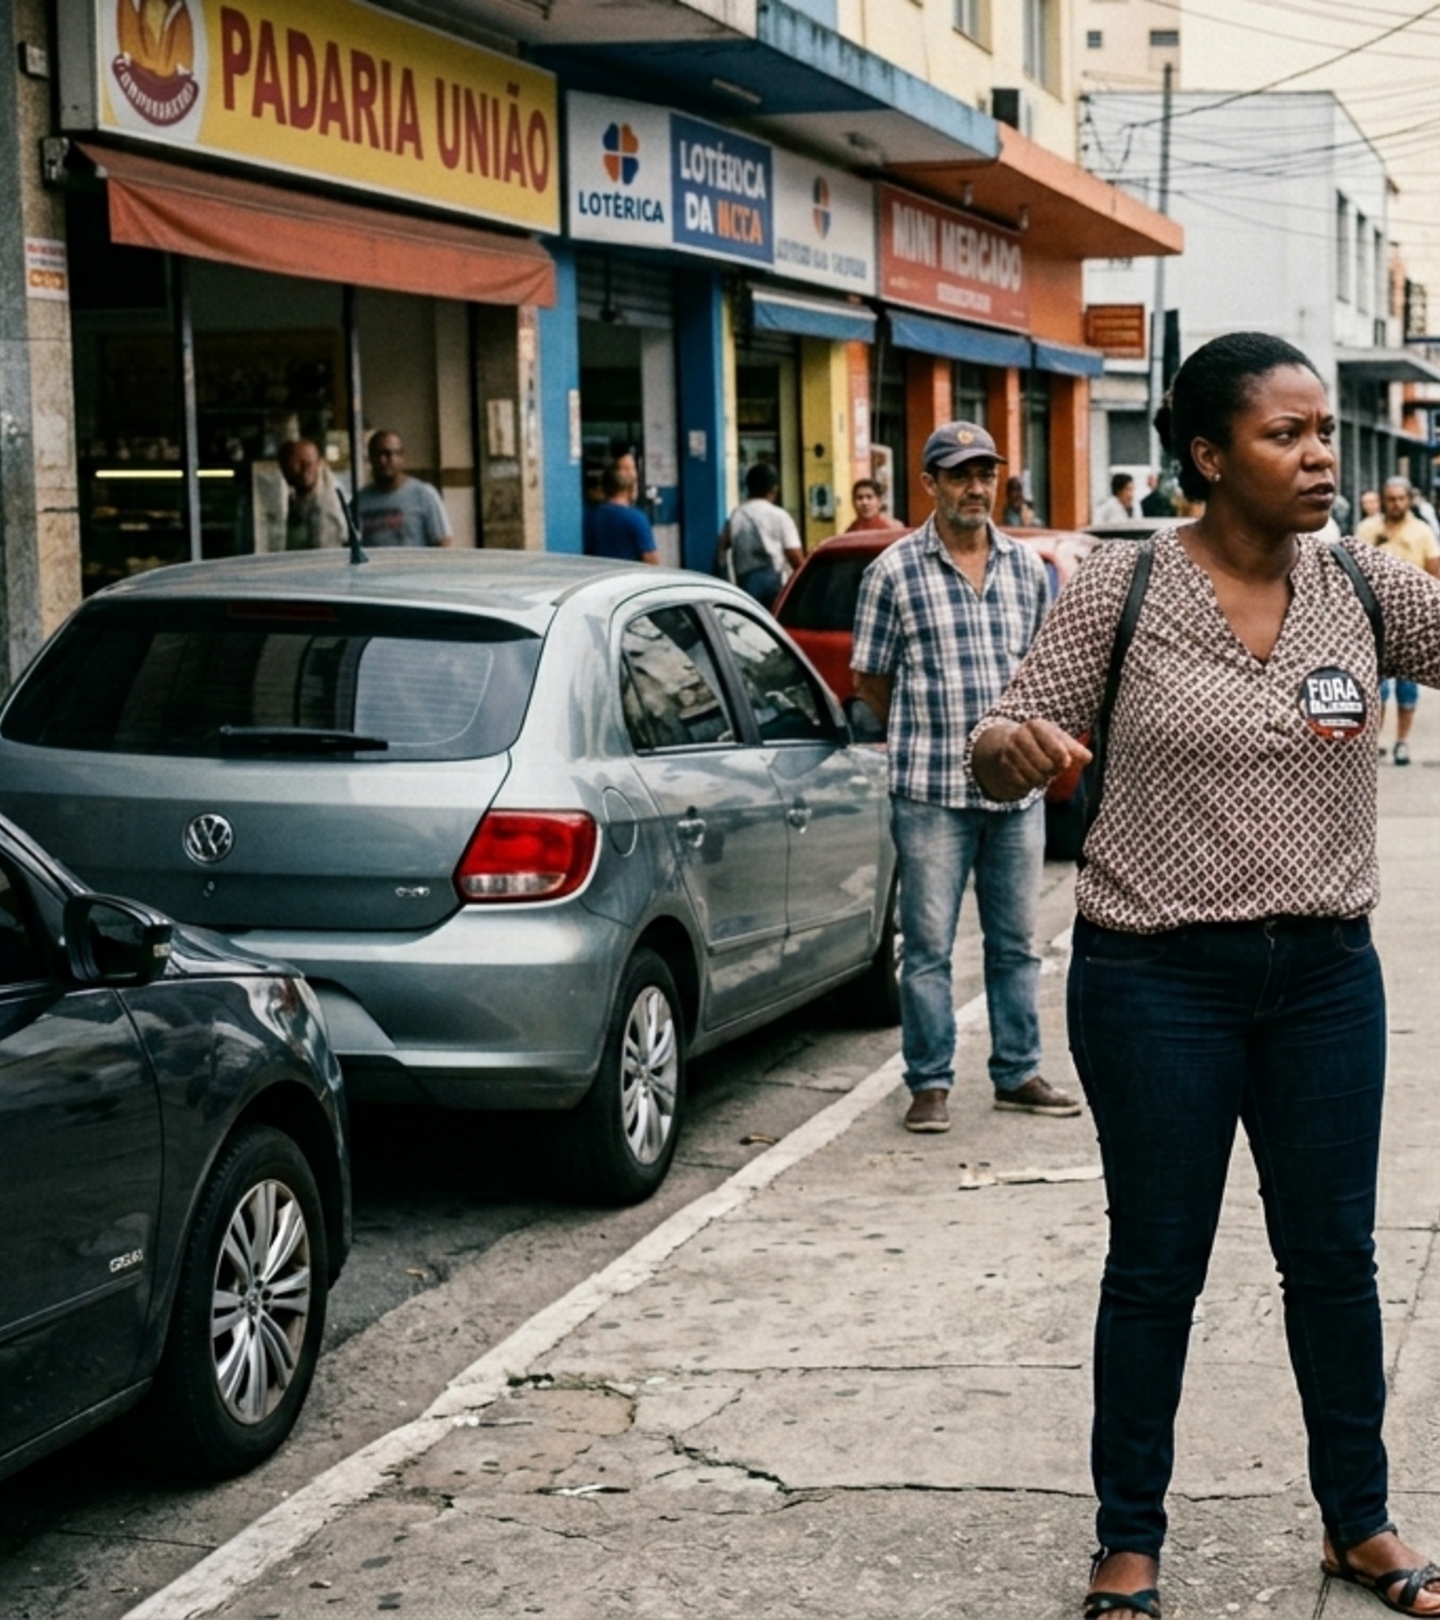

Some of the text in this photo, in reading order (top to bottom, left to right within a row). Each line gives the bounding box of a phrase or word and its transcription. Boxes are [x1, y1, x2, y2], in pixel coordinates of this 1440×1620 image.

[221, 5, 424, 161] PADARIA
[435, 77, 550, 194] UNIÃO
[685, 191, 714, 235] DA
[941, 219, 1023, 294] MERCADO
[1307, 678, 1360, 702] FORA
